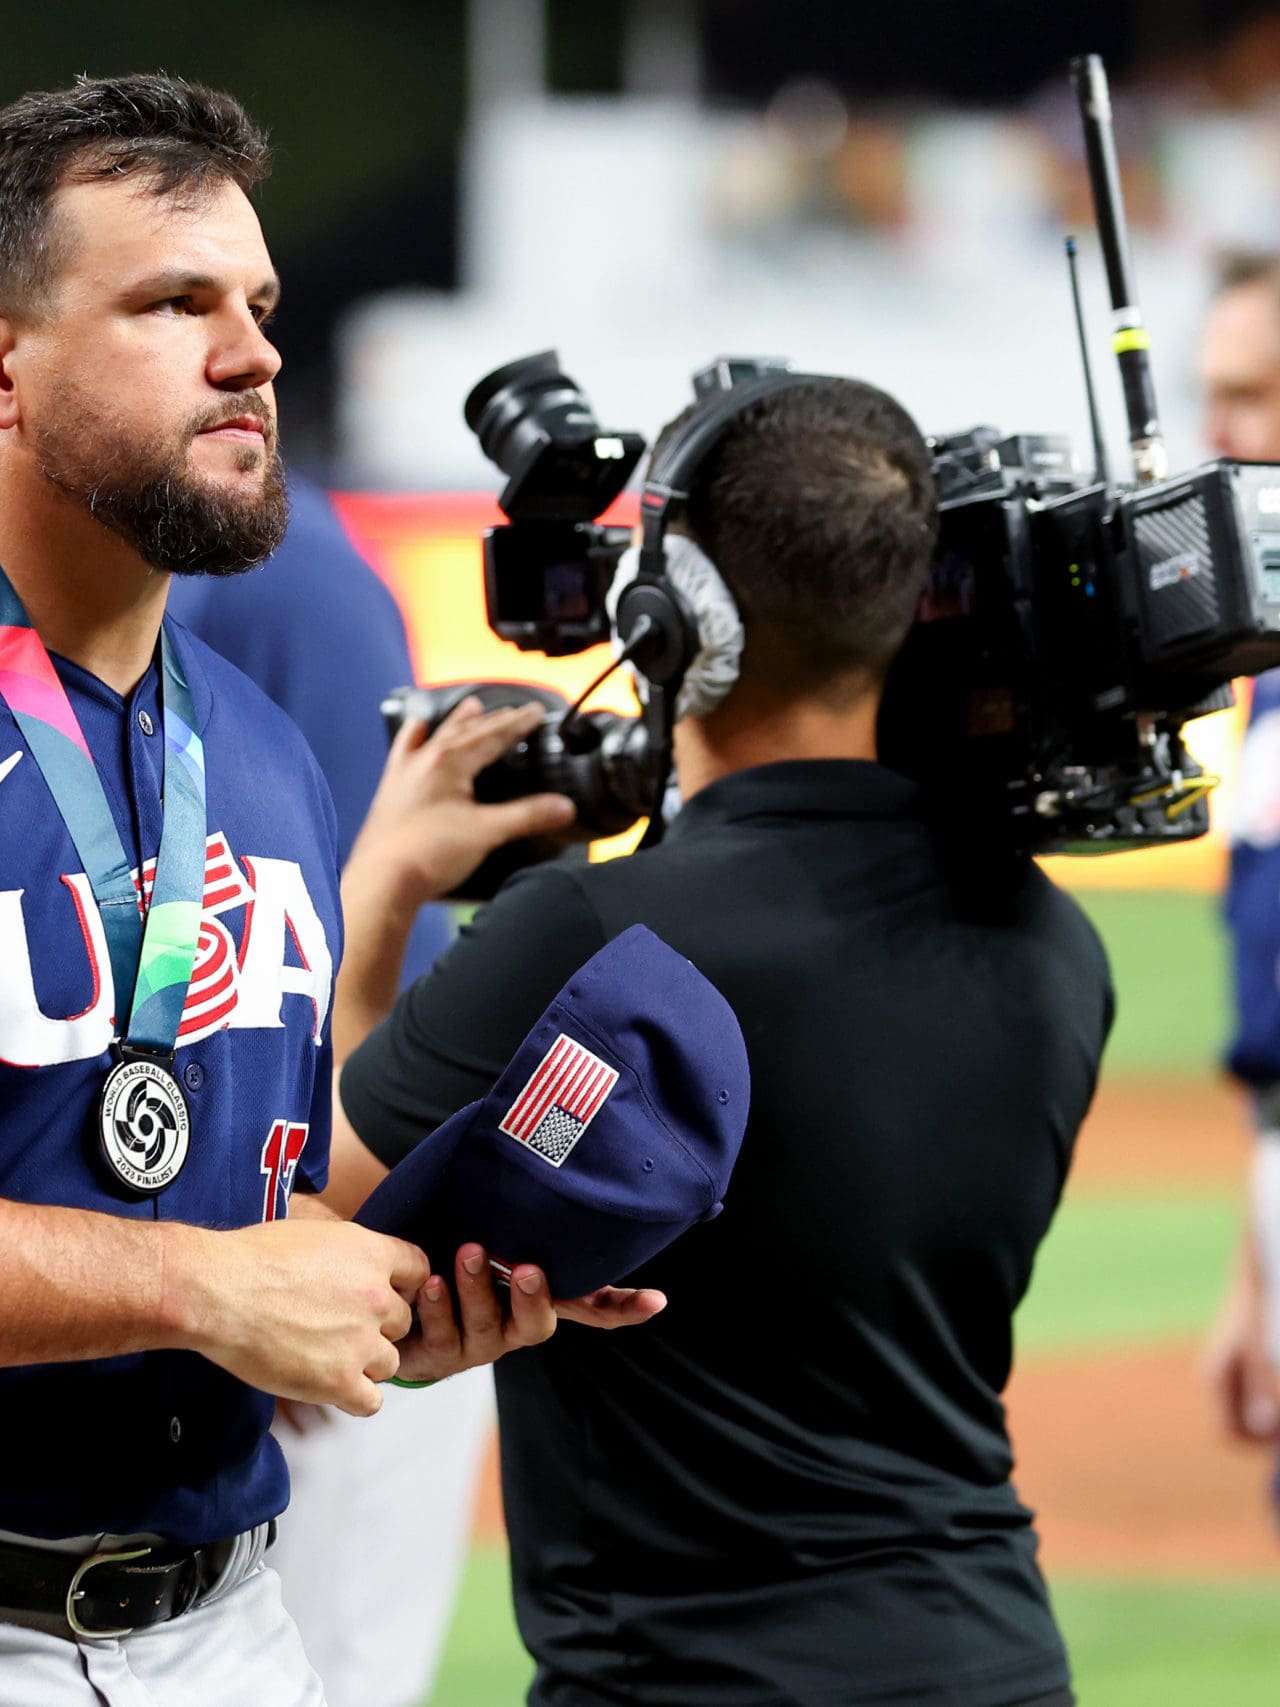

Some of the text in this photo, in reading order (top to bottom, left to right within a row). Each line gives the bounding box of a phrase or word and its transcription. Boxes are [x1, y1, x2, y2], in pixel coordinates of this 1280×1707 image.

[105, 1064, 187, 1131] WORLD BASEBALL CLASSIC
[137, 1166, 174, 1185] FINALIST
